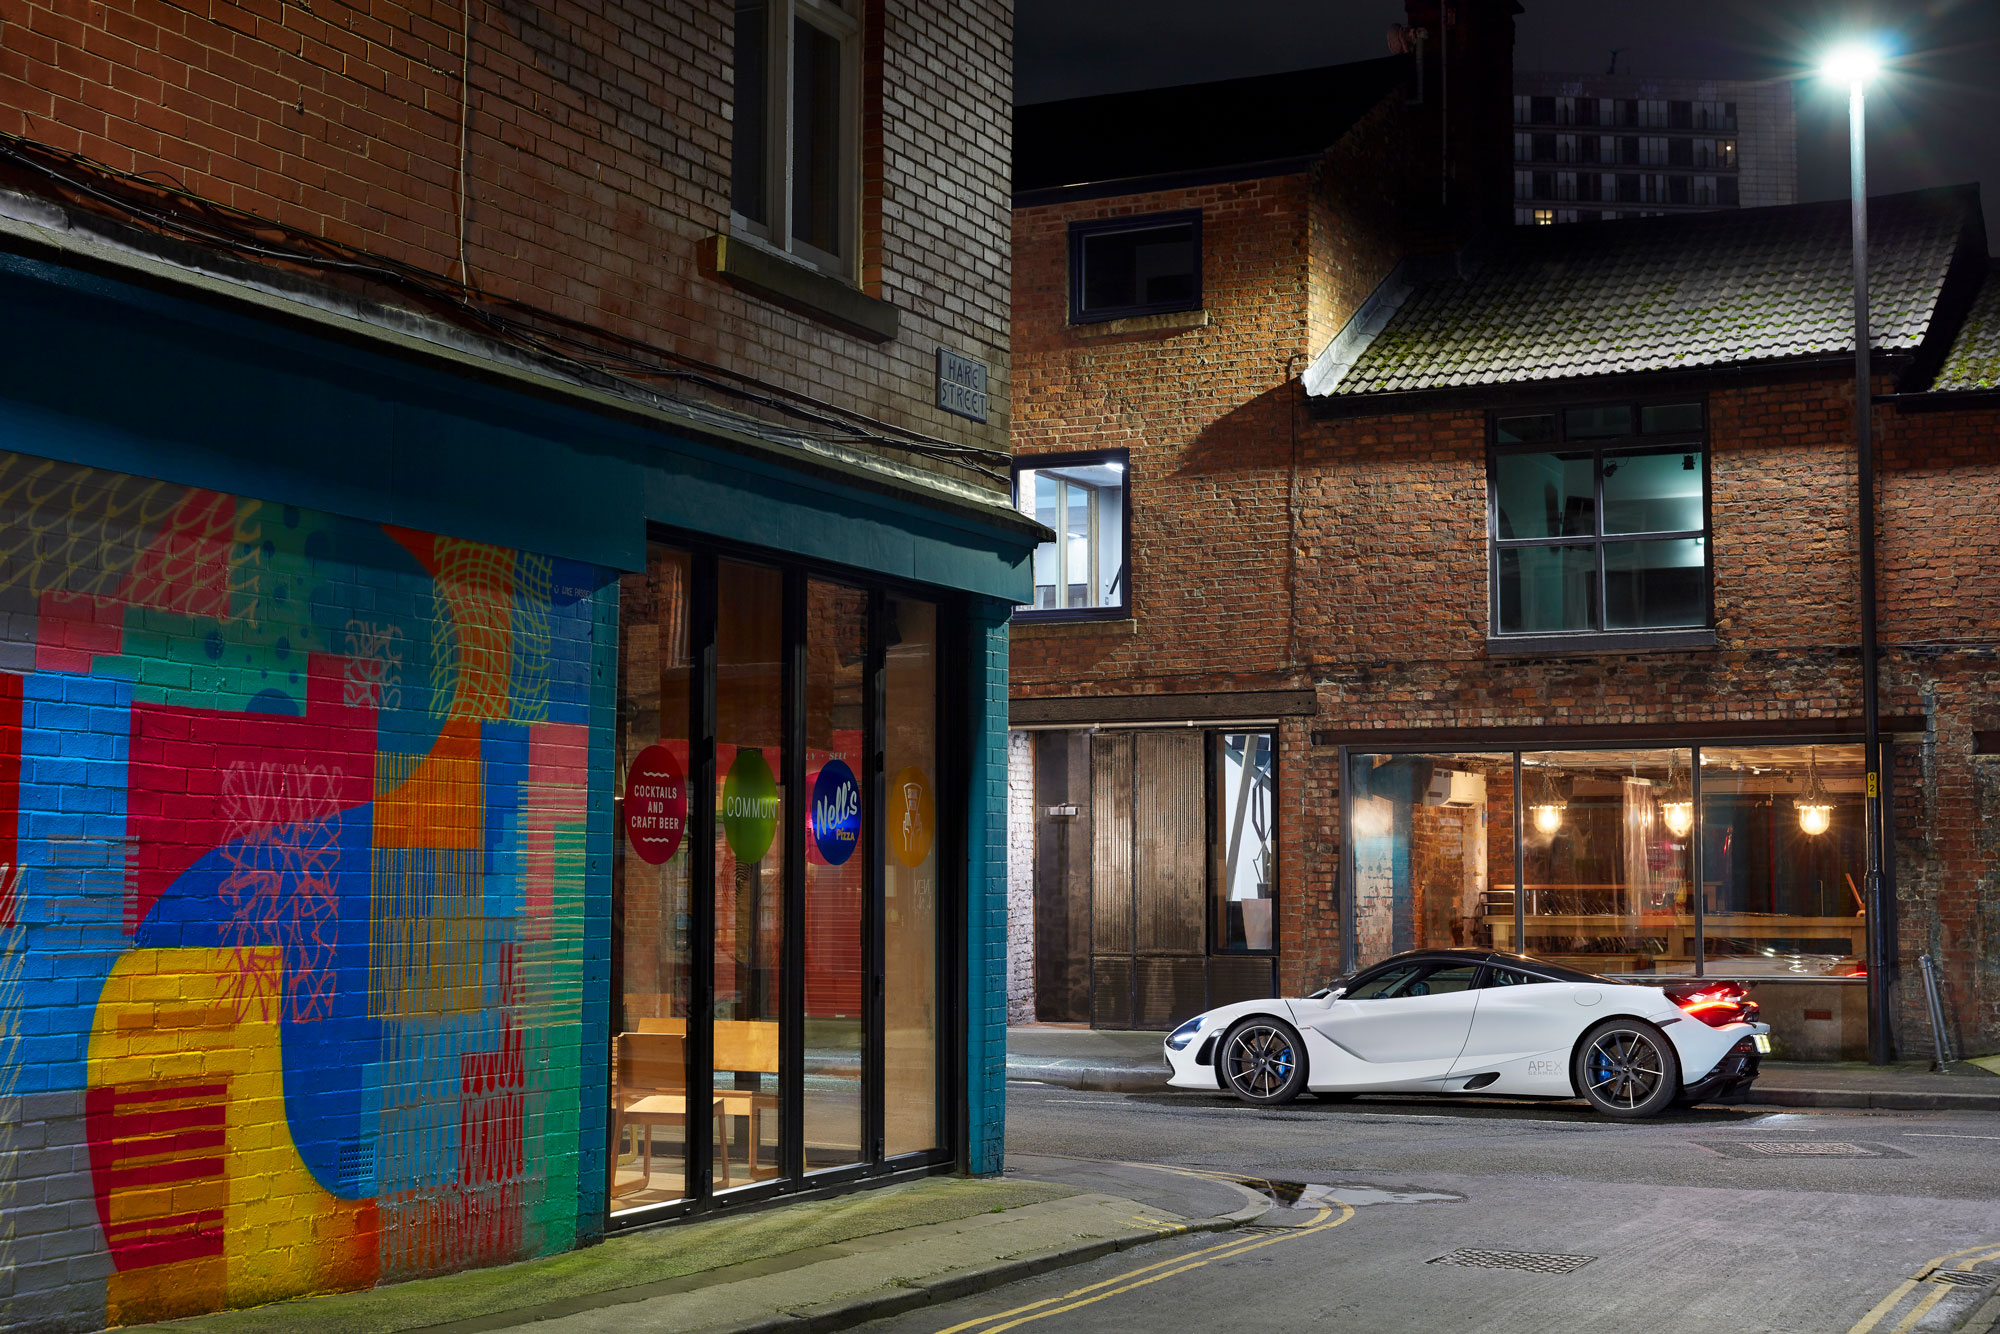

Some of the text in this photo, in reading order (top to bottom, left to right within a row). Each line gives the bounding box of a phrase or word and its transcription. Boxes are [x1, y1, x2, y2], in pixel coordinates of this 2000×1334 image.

[949, 358, 979, 389] HARE
[941, 381, 986, 415] STREET
[828, 752, 847, 761] SELL
[634, 784, 678, 800] COCKTAILS
[647, 801, 664, 814] AND
[726, 796, 776, 819] COMMON
[816, 780, 858, 841] Nell's
[631, 815, 679, 830] CRAFT BEER
[1528, 1060, 1562, 1071] APEX
